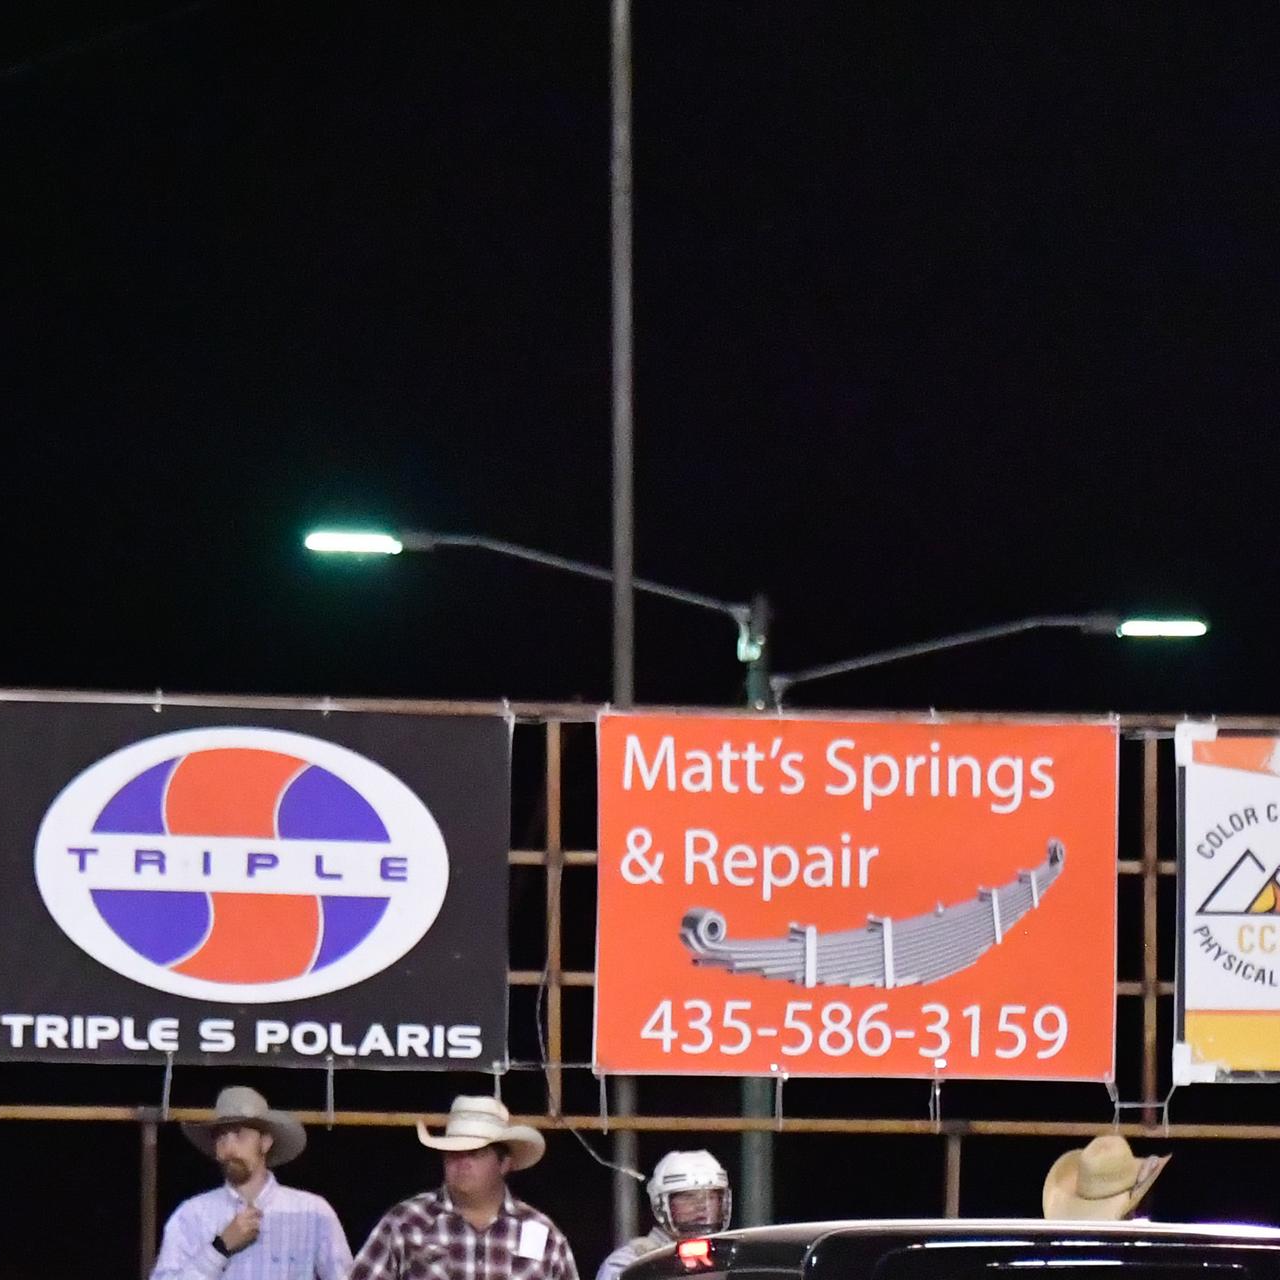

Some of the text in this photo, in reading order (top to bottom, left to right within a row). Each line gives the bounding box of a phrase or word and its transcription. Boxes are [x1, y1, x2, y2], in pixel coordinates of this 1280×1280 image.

[824, 739, 1055, 815] Springs
[1196, 807, 1259, 860] COLOR
[67, 847, 409, 883] TRIPLE
[621, 828, 880, 902] & Repair
[1193, 924, 1278, 987] PHYSICAL
[0, 1014, 483, 1059] TRIPLE S POLARIS
[639, 1000, 1069, 1060] 435-586-3159
